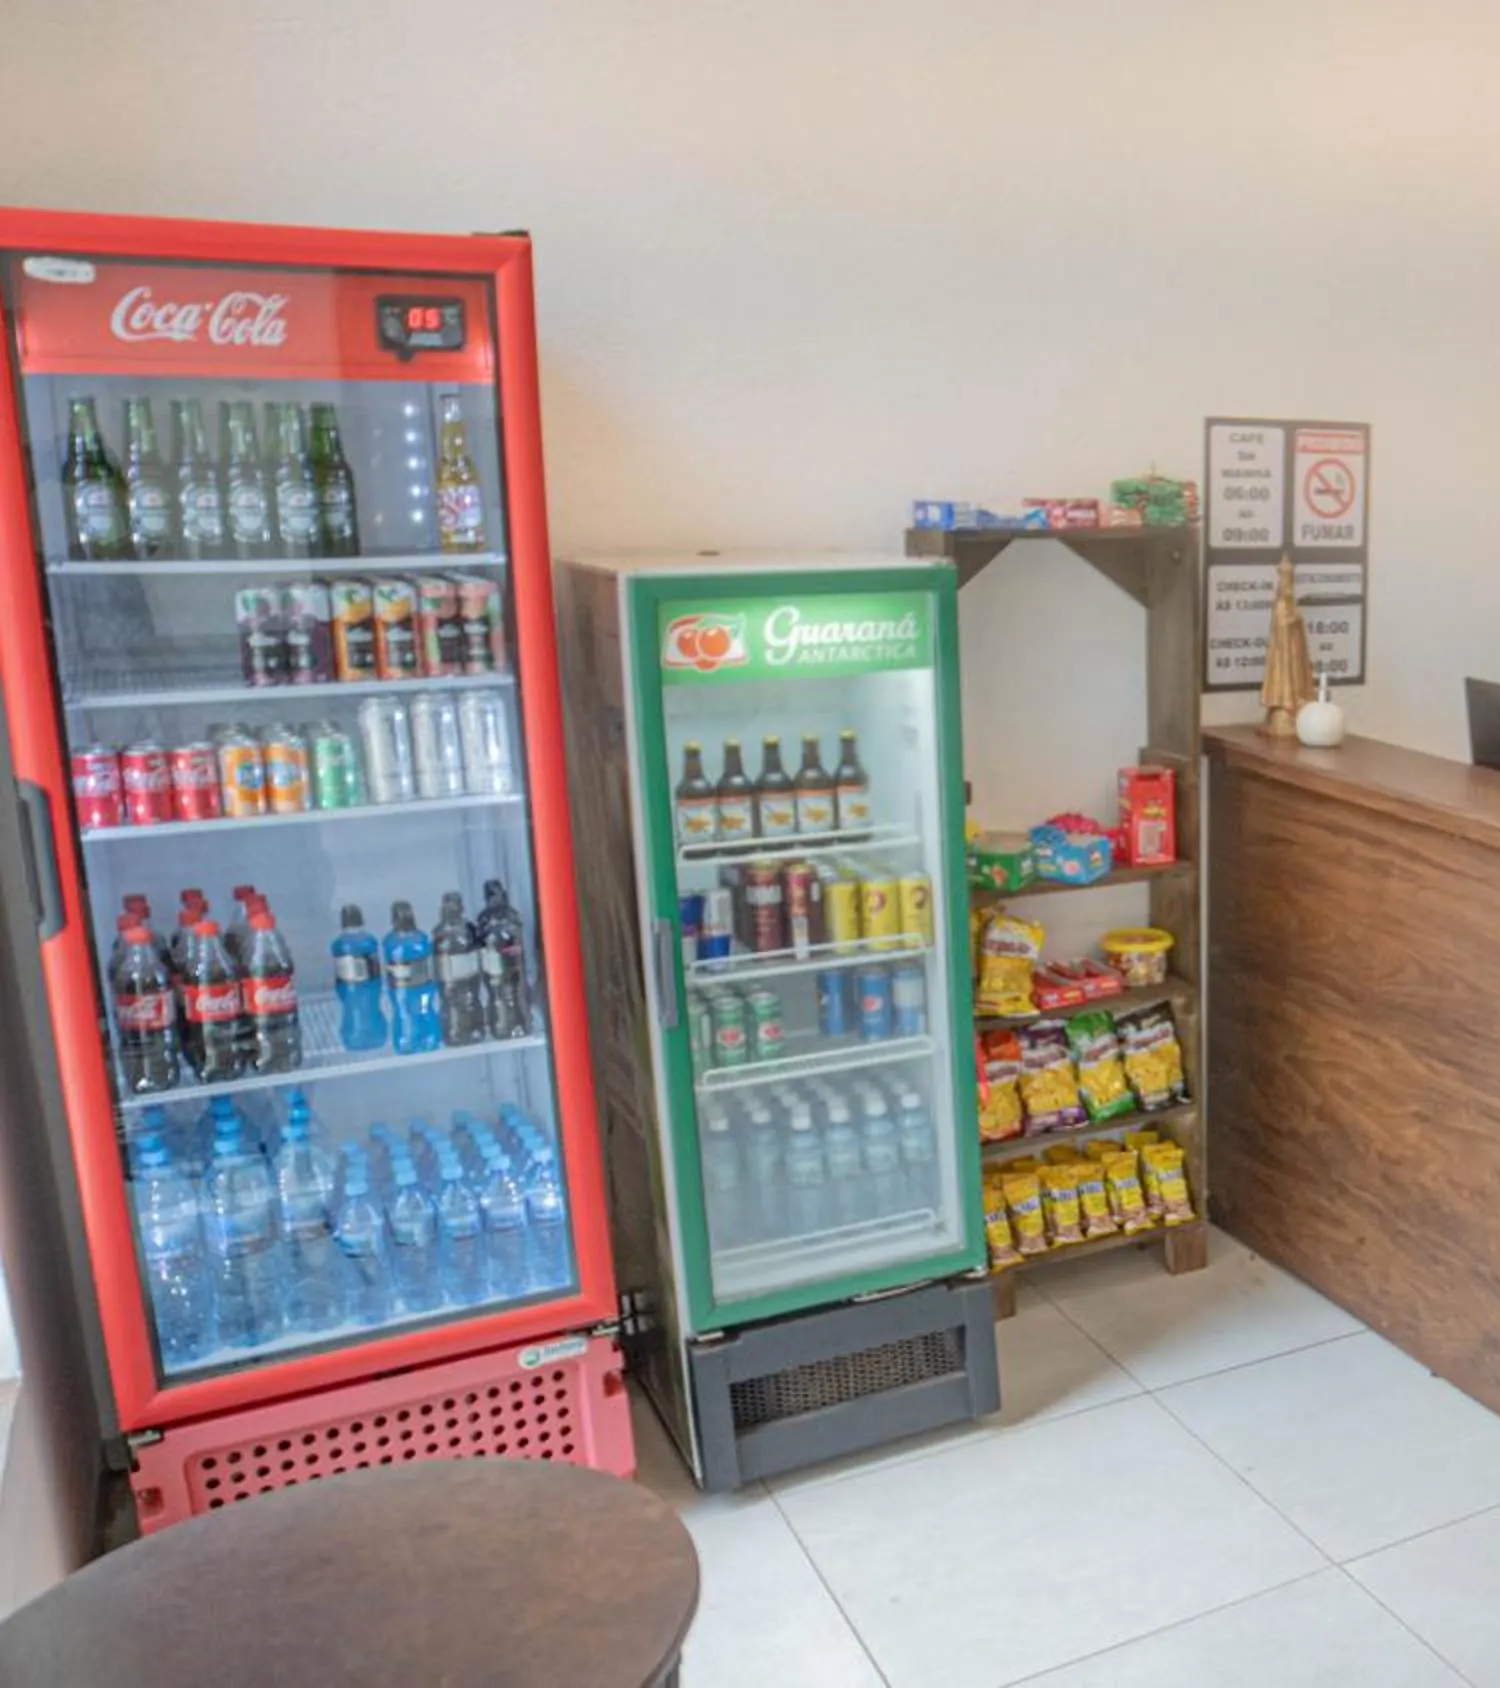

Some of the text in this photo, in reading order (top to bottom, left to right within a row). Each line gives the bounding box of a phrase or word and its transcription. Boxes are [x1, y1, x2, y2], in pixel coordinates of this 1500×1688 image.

[111, 286, 289, 346] Coca-Cola
[1301, 523, 1355, 540] FUMAR
[763, 605, 918, 666] Guaraná
